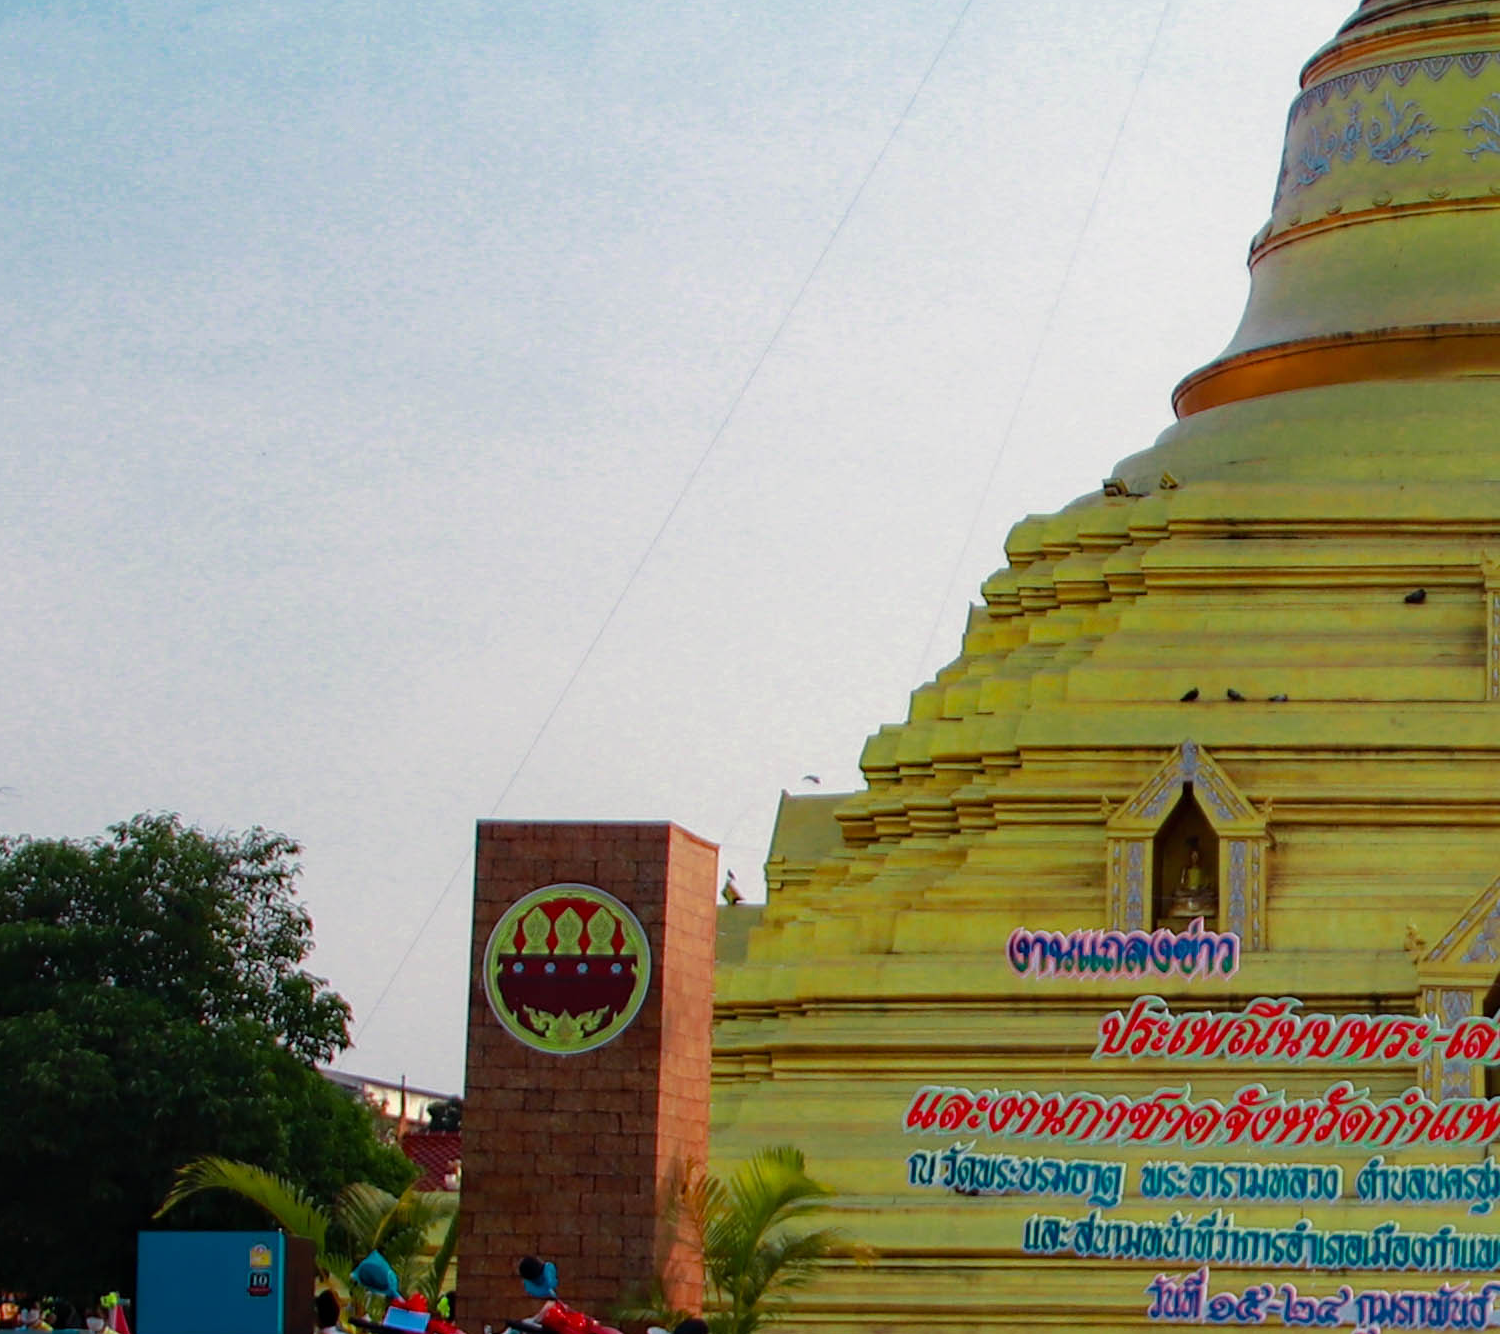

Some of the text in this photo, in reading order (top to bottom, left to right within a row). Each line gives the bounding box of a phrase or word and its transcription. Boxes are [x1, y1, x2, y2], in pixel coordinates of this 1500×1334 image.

[1008, 919, 1238, 978] งานแถลงข่าว
[1141, 1160, 1343, 1201] พระอารามหลวง
